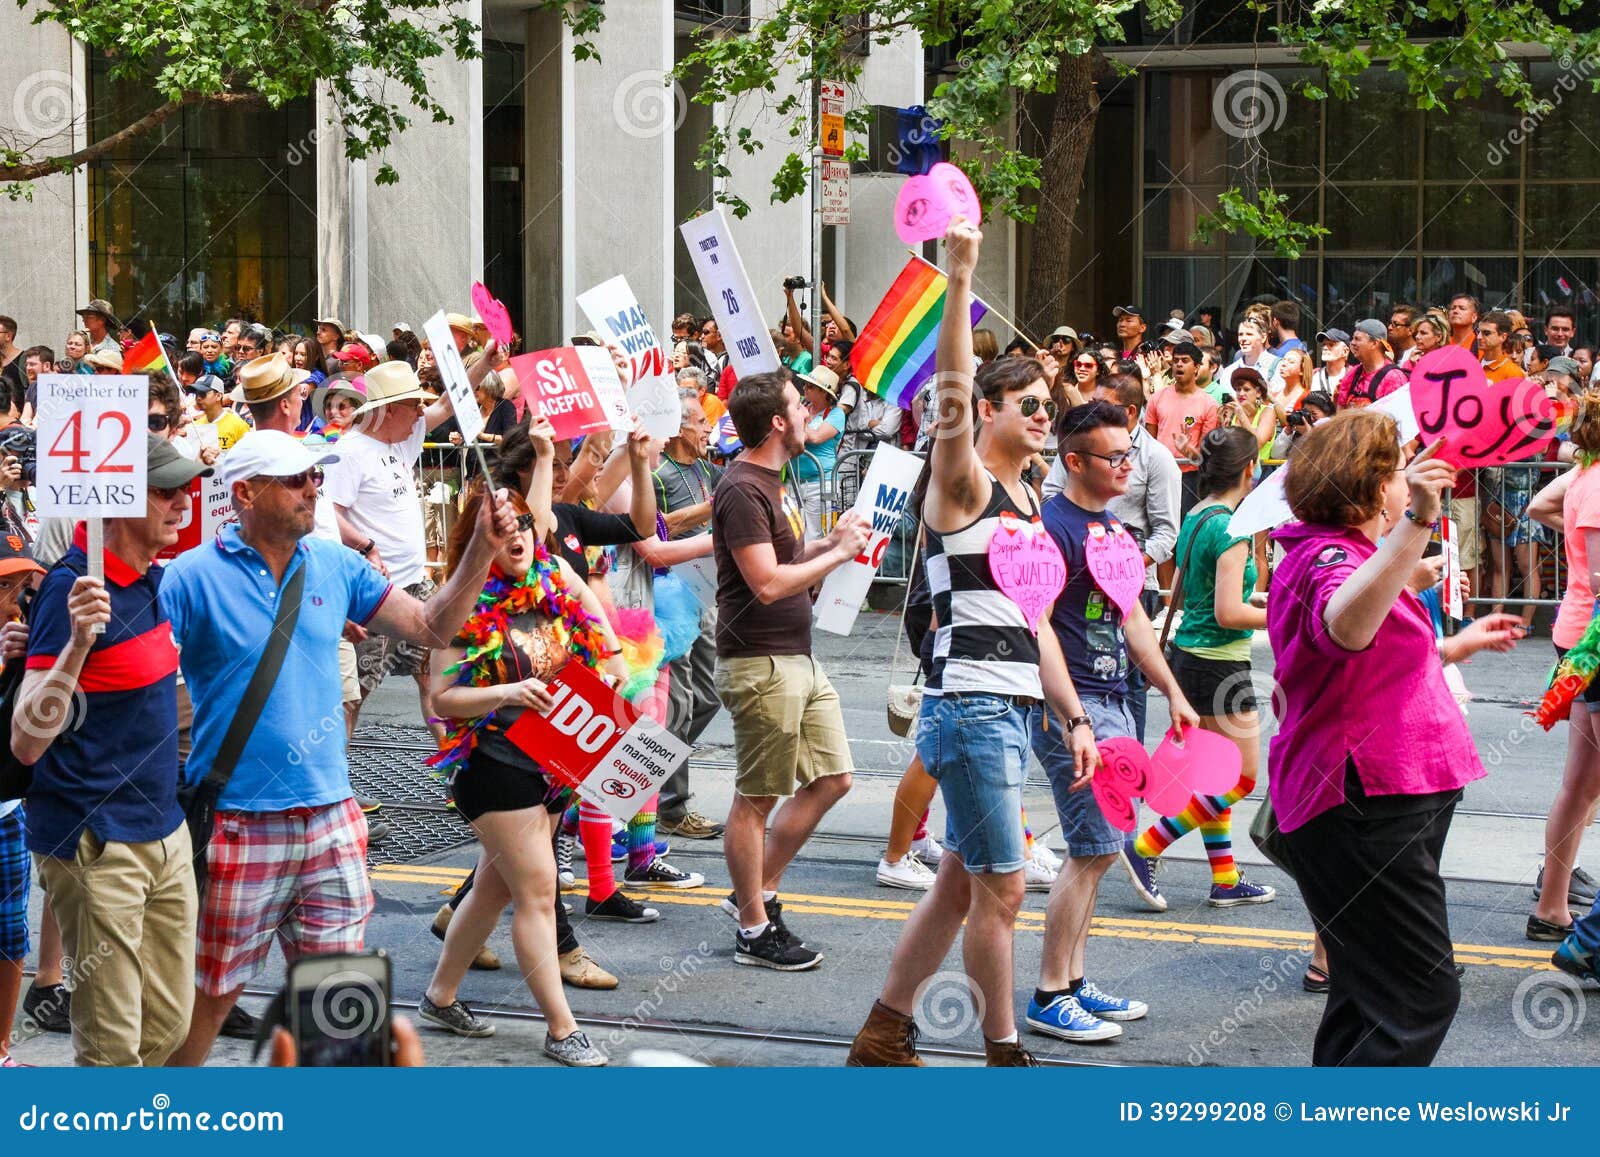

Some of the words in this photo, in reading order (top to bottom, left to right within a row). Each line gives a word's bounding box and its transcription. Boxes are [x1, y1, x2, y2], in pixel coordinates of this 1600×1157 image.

[710, 253, 719, 265] FOR
[722, 288, 740, 316] 26
[620, 330, 655, 355] WHO
[736, 335, 761, 359] YEARS
[47, 383, 113, 401] Together
[118, 383, 139, 398] for
[537, 391, 595, 418] ACEPTO
[48, 410, 134, 474] 42
[49, 484, 135, 505] YEARS
[997, 561, 1065, 588] EQUALITY
[622, 742, 666, 778] marriage
[637, 733, 677, 763] support
[612, 758, 653, 791] equality
